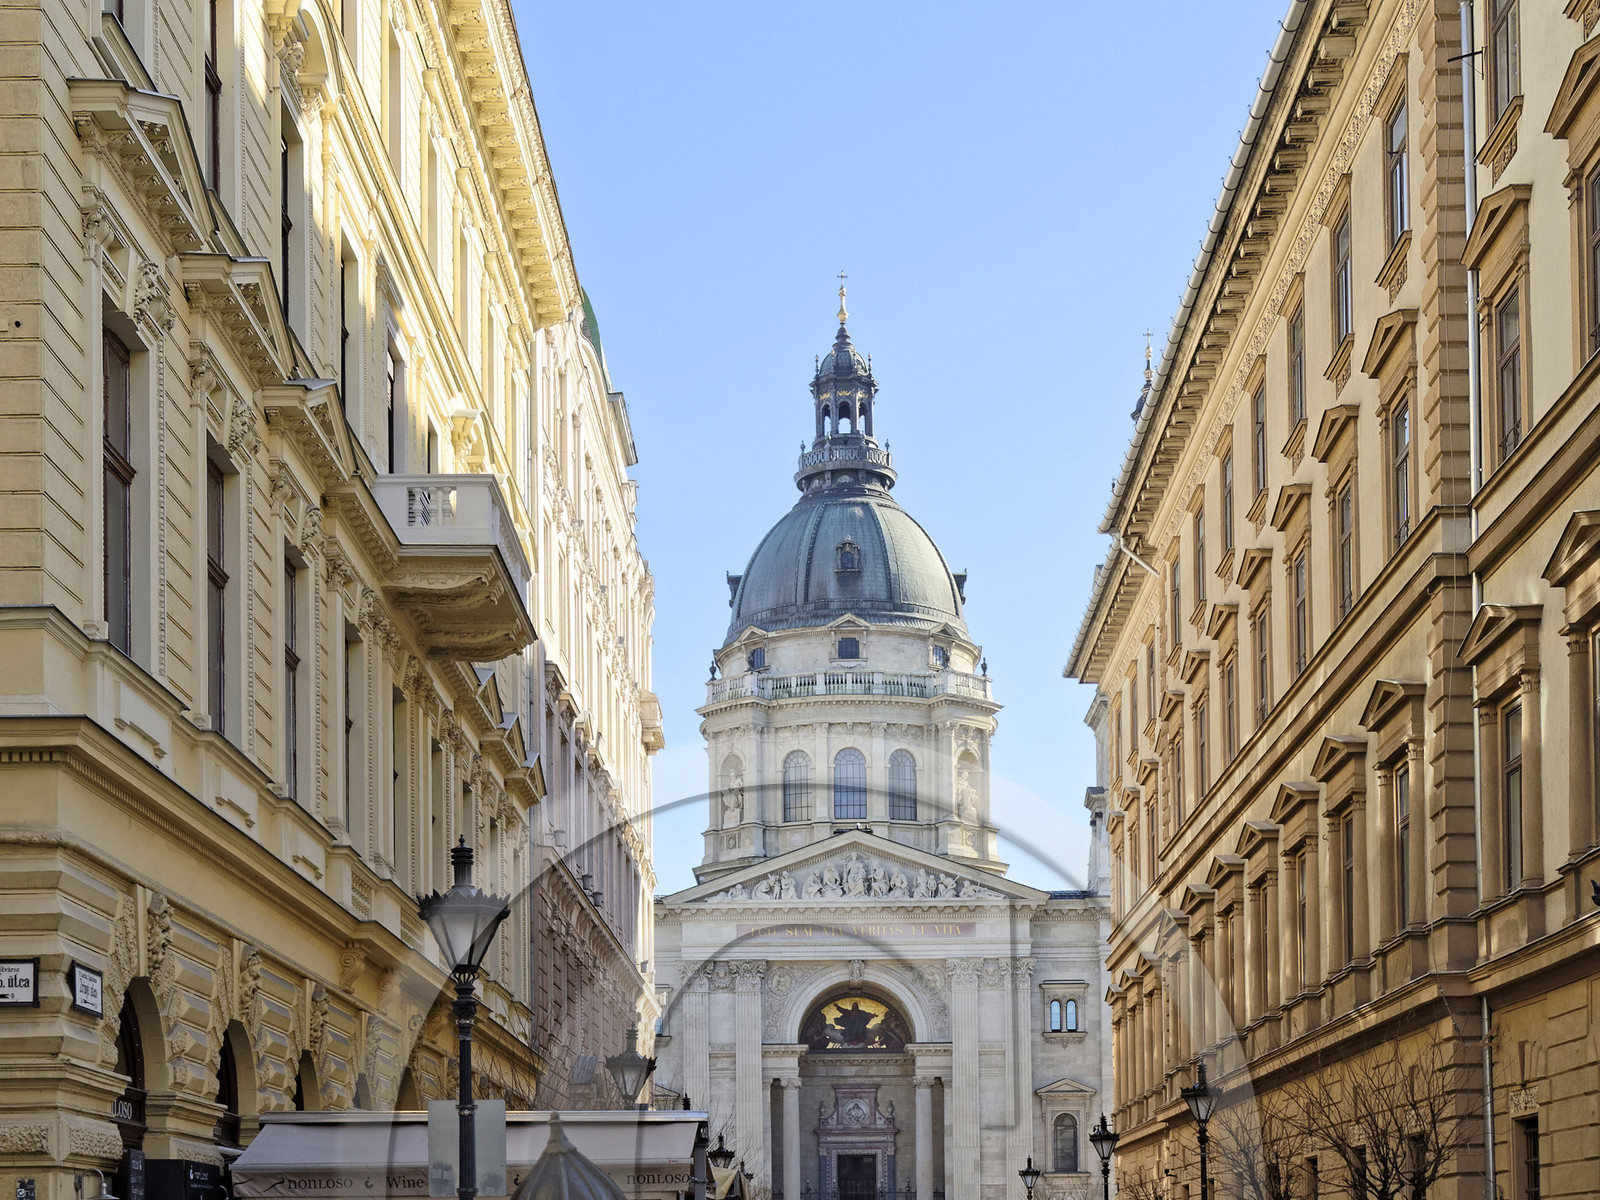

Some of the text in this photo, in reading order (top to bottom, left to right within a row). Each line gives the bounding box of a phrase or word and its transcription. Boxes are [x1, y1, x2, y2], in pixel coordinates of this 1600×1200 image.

[751, 924, 962, 937] EGO SUM VIA VERITAS ET VITA
[386, 1176, 424, 1189] Wine
